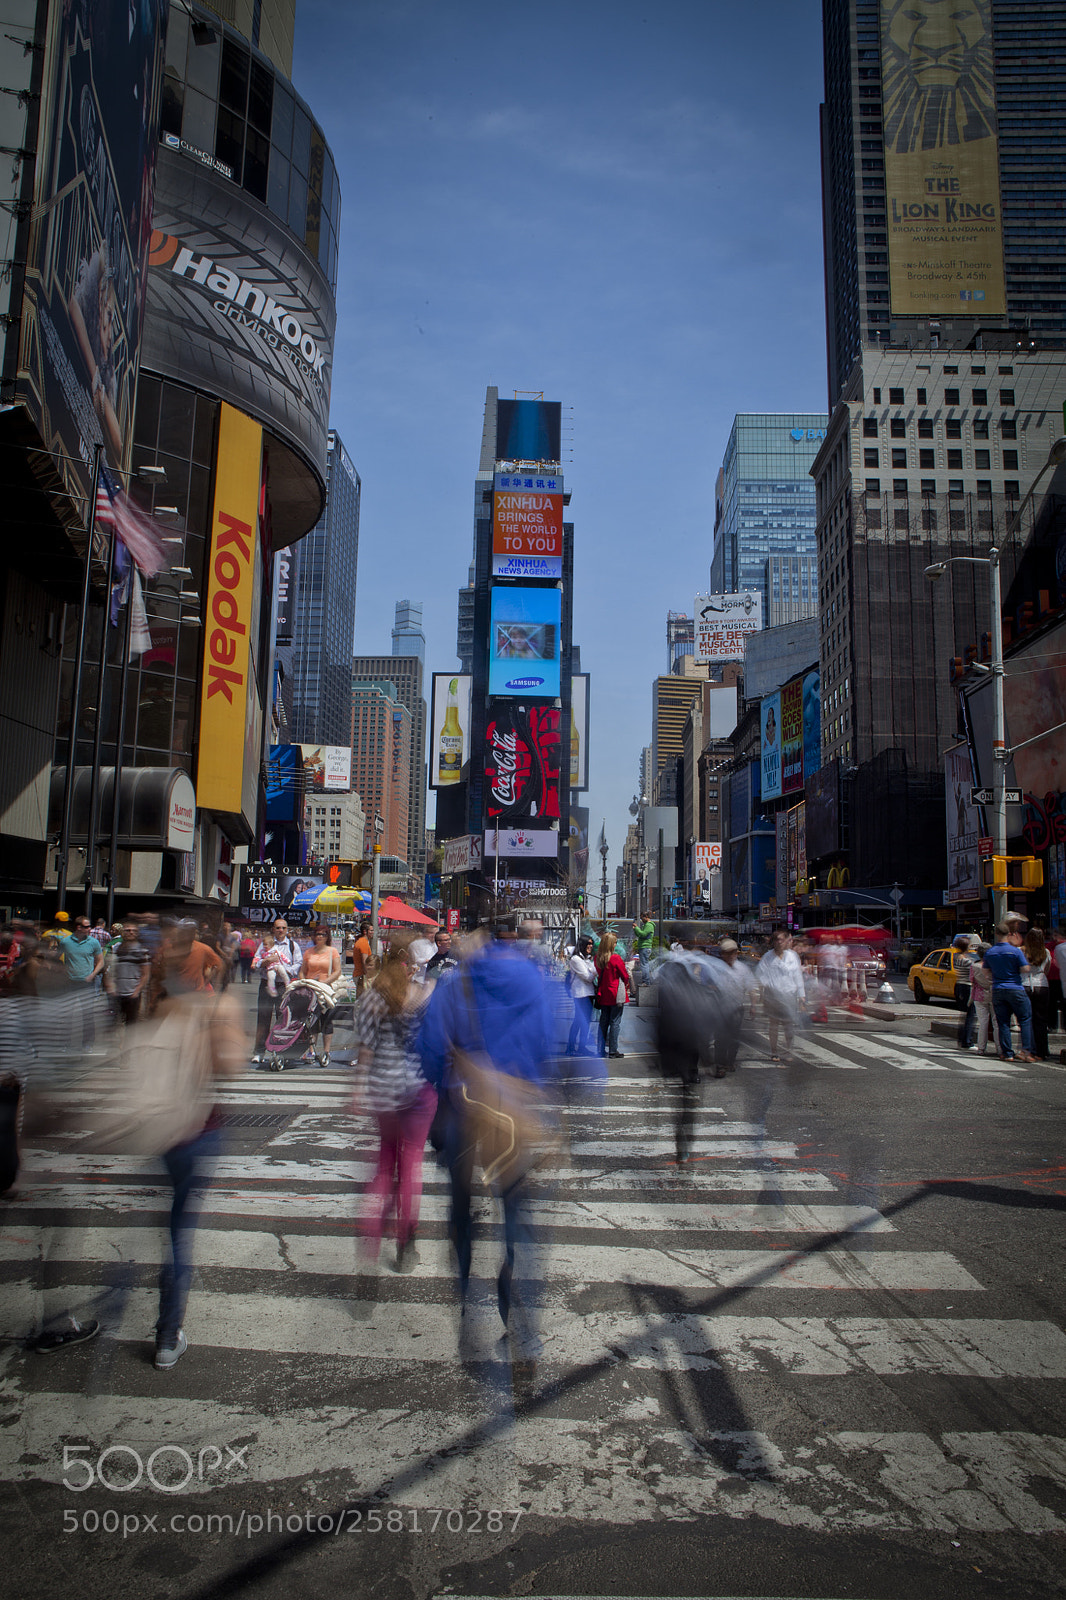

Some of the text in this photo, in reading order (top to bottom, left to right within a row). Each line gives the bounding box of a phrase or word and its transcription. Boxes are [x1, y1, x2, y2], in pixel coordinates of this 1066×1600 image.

[925, 177, 960, 192] THE
[892, 198, 995, 223] LION KING
[918, 260, 992, 269] Minskoff Theatre
[907, 272, 987, 282] Broadway & 45th
[213, 300, 324, 398] driving emotion
[501, 477, 557, 489] 新华通讯社
[497, 496, 554, 511] XINHUA
[497, 512, 544, 523] BRINGS
[500, 524, 557, 535] THE WORLD
[503, 537, 556, 551] TO YOU
[507, 558, 548, 568] XINHUA
[498, 567, 557, 576] NEWS AGENCY
[207, 510, 252, 706] Kodak
[699, 631, 724, 642] THE
[699, 640, 743, 649] MUSICAL
[782, 681, 801, 704] THE
[782, 709, 801, 728] GOES
[783, 722, 802, 741] WILD!
[392, 721, 400, 782] NOVOTEL
[491, 729, 517, 806] Coca-Cola
[246, 865, 325, 875] MARQUIS
[248, 877, 278, 893] Jekyll
[492, 879, 546, 888] TOGETHER
[251, 888, 281, 904] Hyde
[538, 888, 550, 896] HOT
[550, 888, 567, 896] DOGS
[450, 910, 458, 925] tkts
